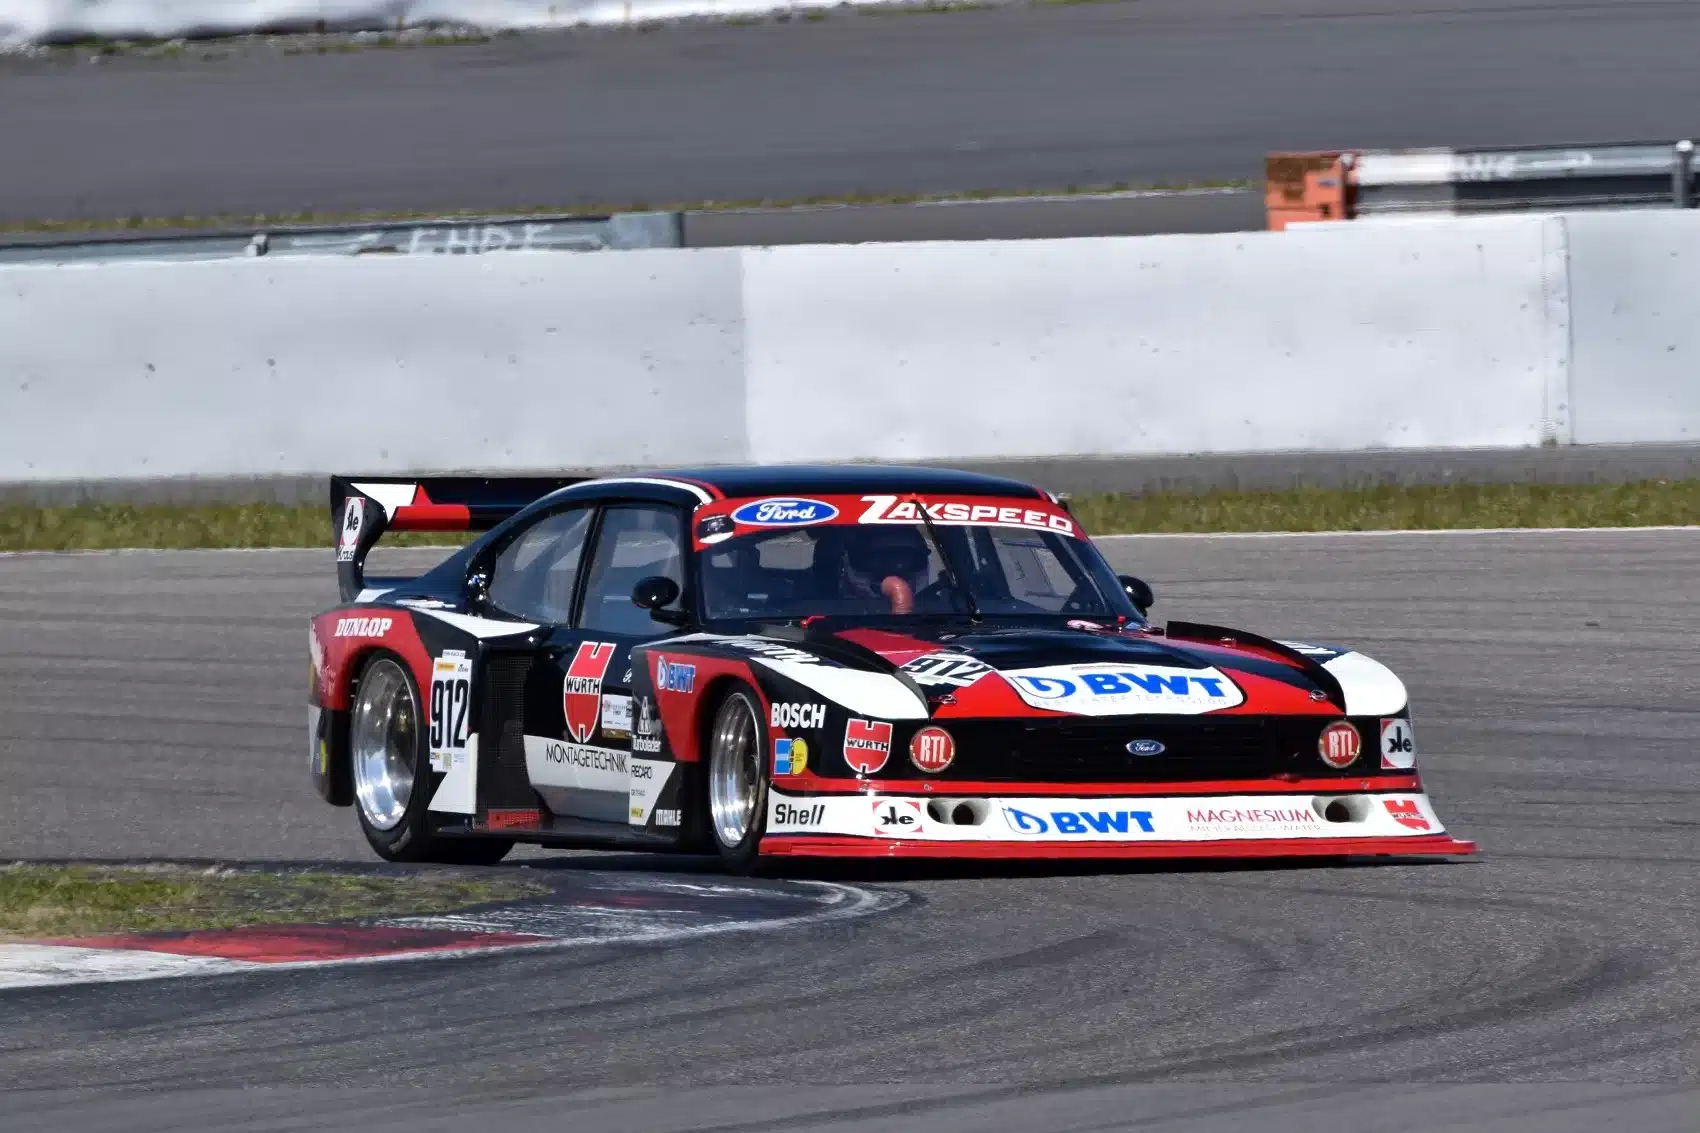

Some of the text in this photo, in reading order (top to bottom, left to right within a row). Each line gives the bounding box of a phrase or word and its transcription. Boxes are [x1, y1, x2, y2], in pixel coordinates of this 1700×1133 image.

[755, 500, 817, 522] Ford
[859, 495, 1074, 534] ZAKSPEED
[334, 617, 393, 637] DUNLOP
[904, 657, 993, 682] 912
[1078, 672, 1226, 698] BWT
[430, 679, 469, 749] 912
[770, 702, 827, 729] BOSCH
[919, 734, 948, 764] RTL
[1328, 731, 1356, 759] RTL
[546, 743, 628, 774] MONTAGETECHNIK
[631, 764, 652, 780] RECARO
[655, 808, 683, 827] MAHLE
[774, 803, 826, 826] Shell
[1049, 811, 1156, 834] BWT
[1186, 808, 1316, 823] MAGNESIUM
